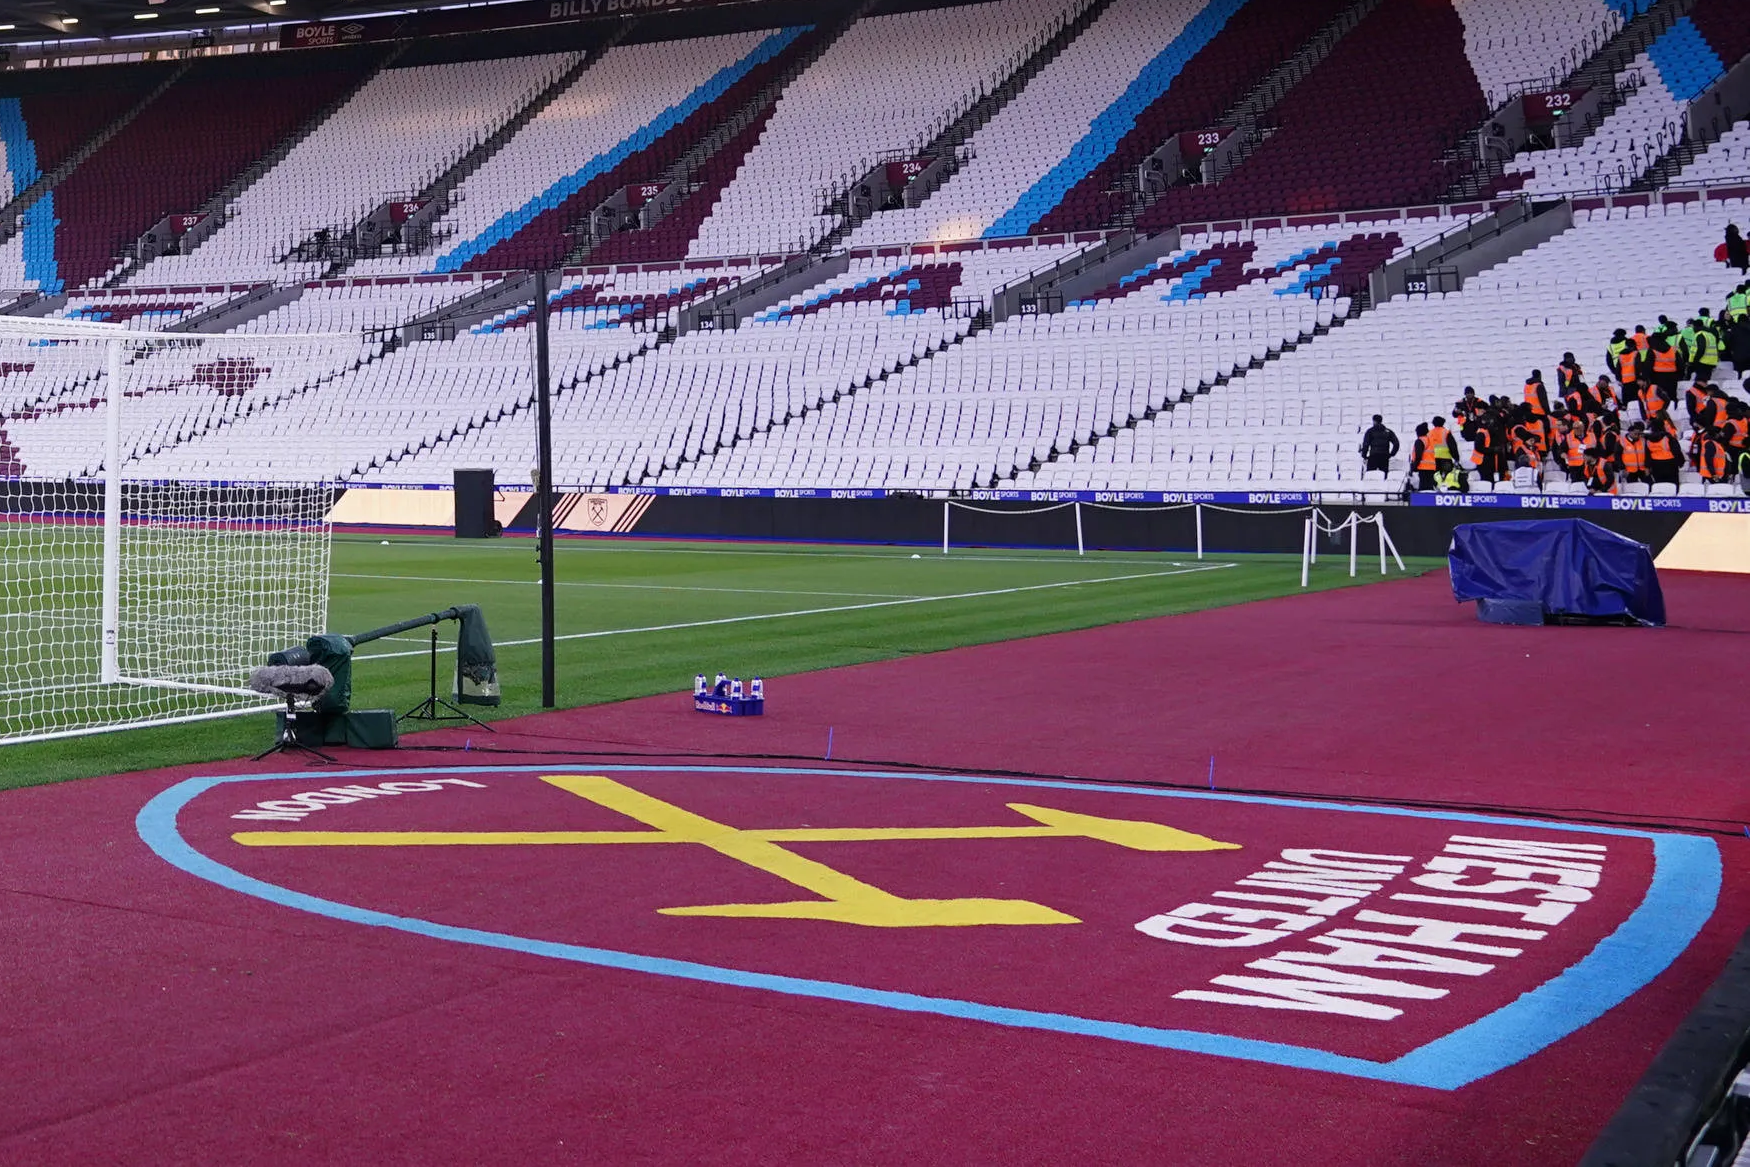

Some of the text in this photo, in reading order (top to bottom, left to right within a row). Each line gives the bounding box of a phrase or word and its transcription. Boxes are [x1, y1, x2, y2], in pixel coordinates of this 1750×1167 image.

[296, 25, 336, 39] BOYLE
[308, 36, 334, 46] SPORTS
[1545, 93, 1571, 108] 232
[1198, 133, 1220, 146] 233
[902, 162, 922, 174] 234
[641, 186, 659, 197] 235
[402, 203, 420, 214] 236
[182, 216, 198, 226] 237
[1407, 280, 1426, 292] 132
[1021, 303, 1037, 313] 133
[699, 320, 714, 329] 134
[423, 331, 435, 340] 135
[618, 487, 641, 495] BOYLE
[669, 488, 692, 496] BOYLE
[721, 489, 744, 497] BOYLE
[775, 489, 799, 498] BOYLE
[831, 490, 856, 499] BOYLE
[973, 490, 1000, 501] BOYLE
[1031, 491, 1077, 501] BOYLE SPORTS
[1095, 491, 1144, 502] BOYLE SPORTS
[1163, 492, 1214, 503] BOYLE SPORTS
[1249, 492, 1303, 504] BOYLE SPORTS
[1435, 495, 1497, 507] BOYLE SPORTS
[1521, 496, 1586, 509] BOYLE SPORTS
[1612, 498, 1681, 511] BOYLE SPORTS
[1709, 500, 1750, 512] BOYLE
[230, 778, 488, 822] LONDON
[1134, 848, 1414, 948] UNITED
[1171, 835, 1608, 1021] WEST HAM
